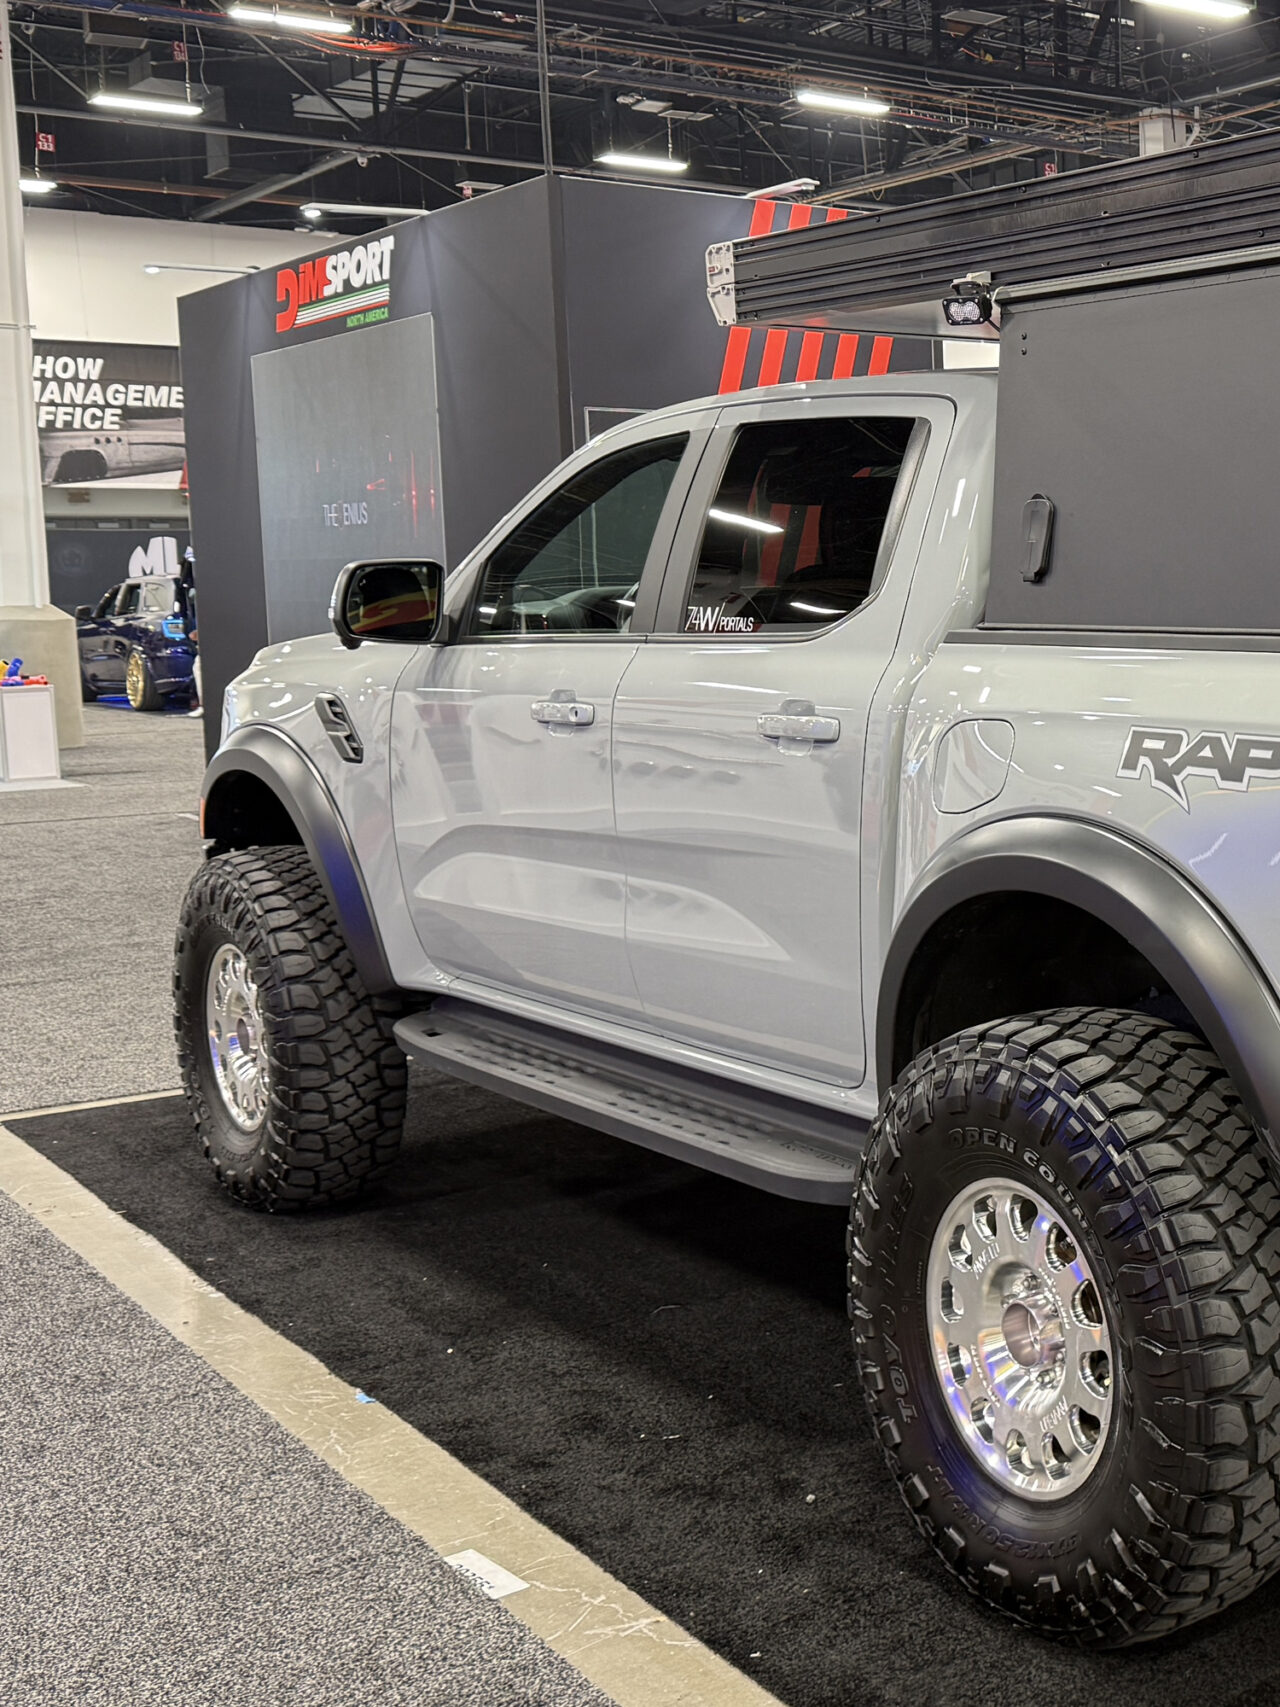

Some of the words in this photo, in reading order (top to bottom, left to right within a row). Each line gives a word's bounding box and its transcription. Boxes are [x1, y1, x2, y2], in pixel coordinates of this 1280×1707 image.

[39, 133, 52, 142] C1
[365, 307, 389, 324] AMERICA
[32, 355, 104, 381] HOW
[32, 380, 184, 408] ANAGEME
[37, 406, 122, 430] FFICE
[947, 1127, 1017, 1155] OPEN
